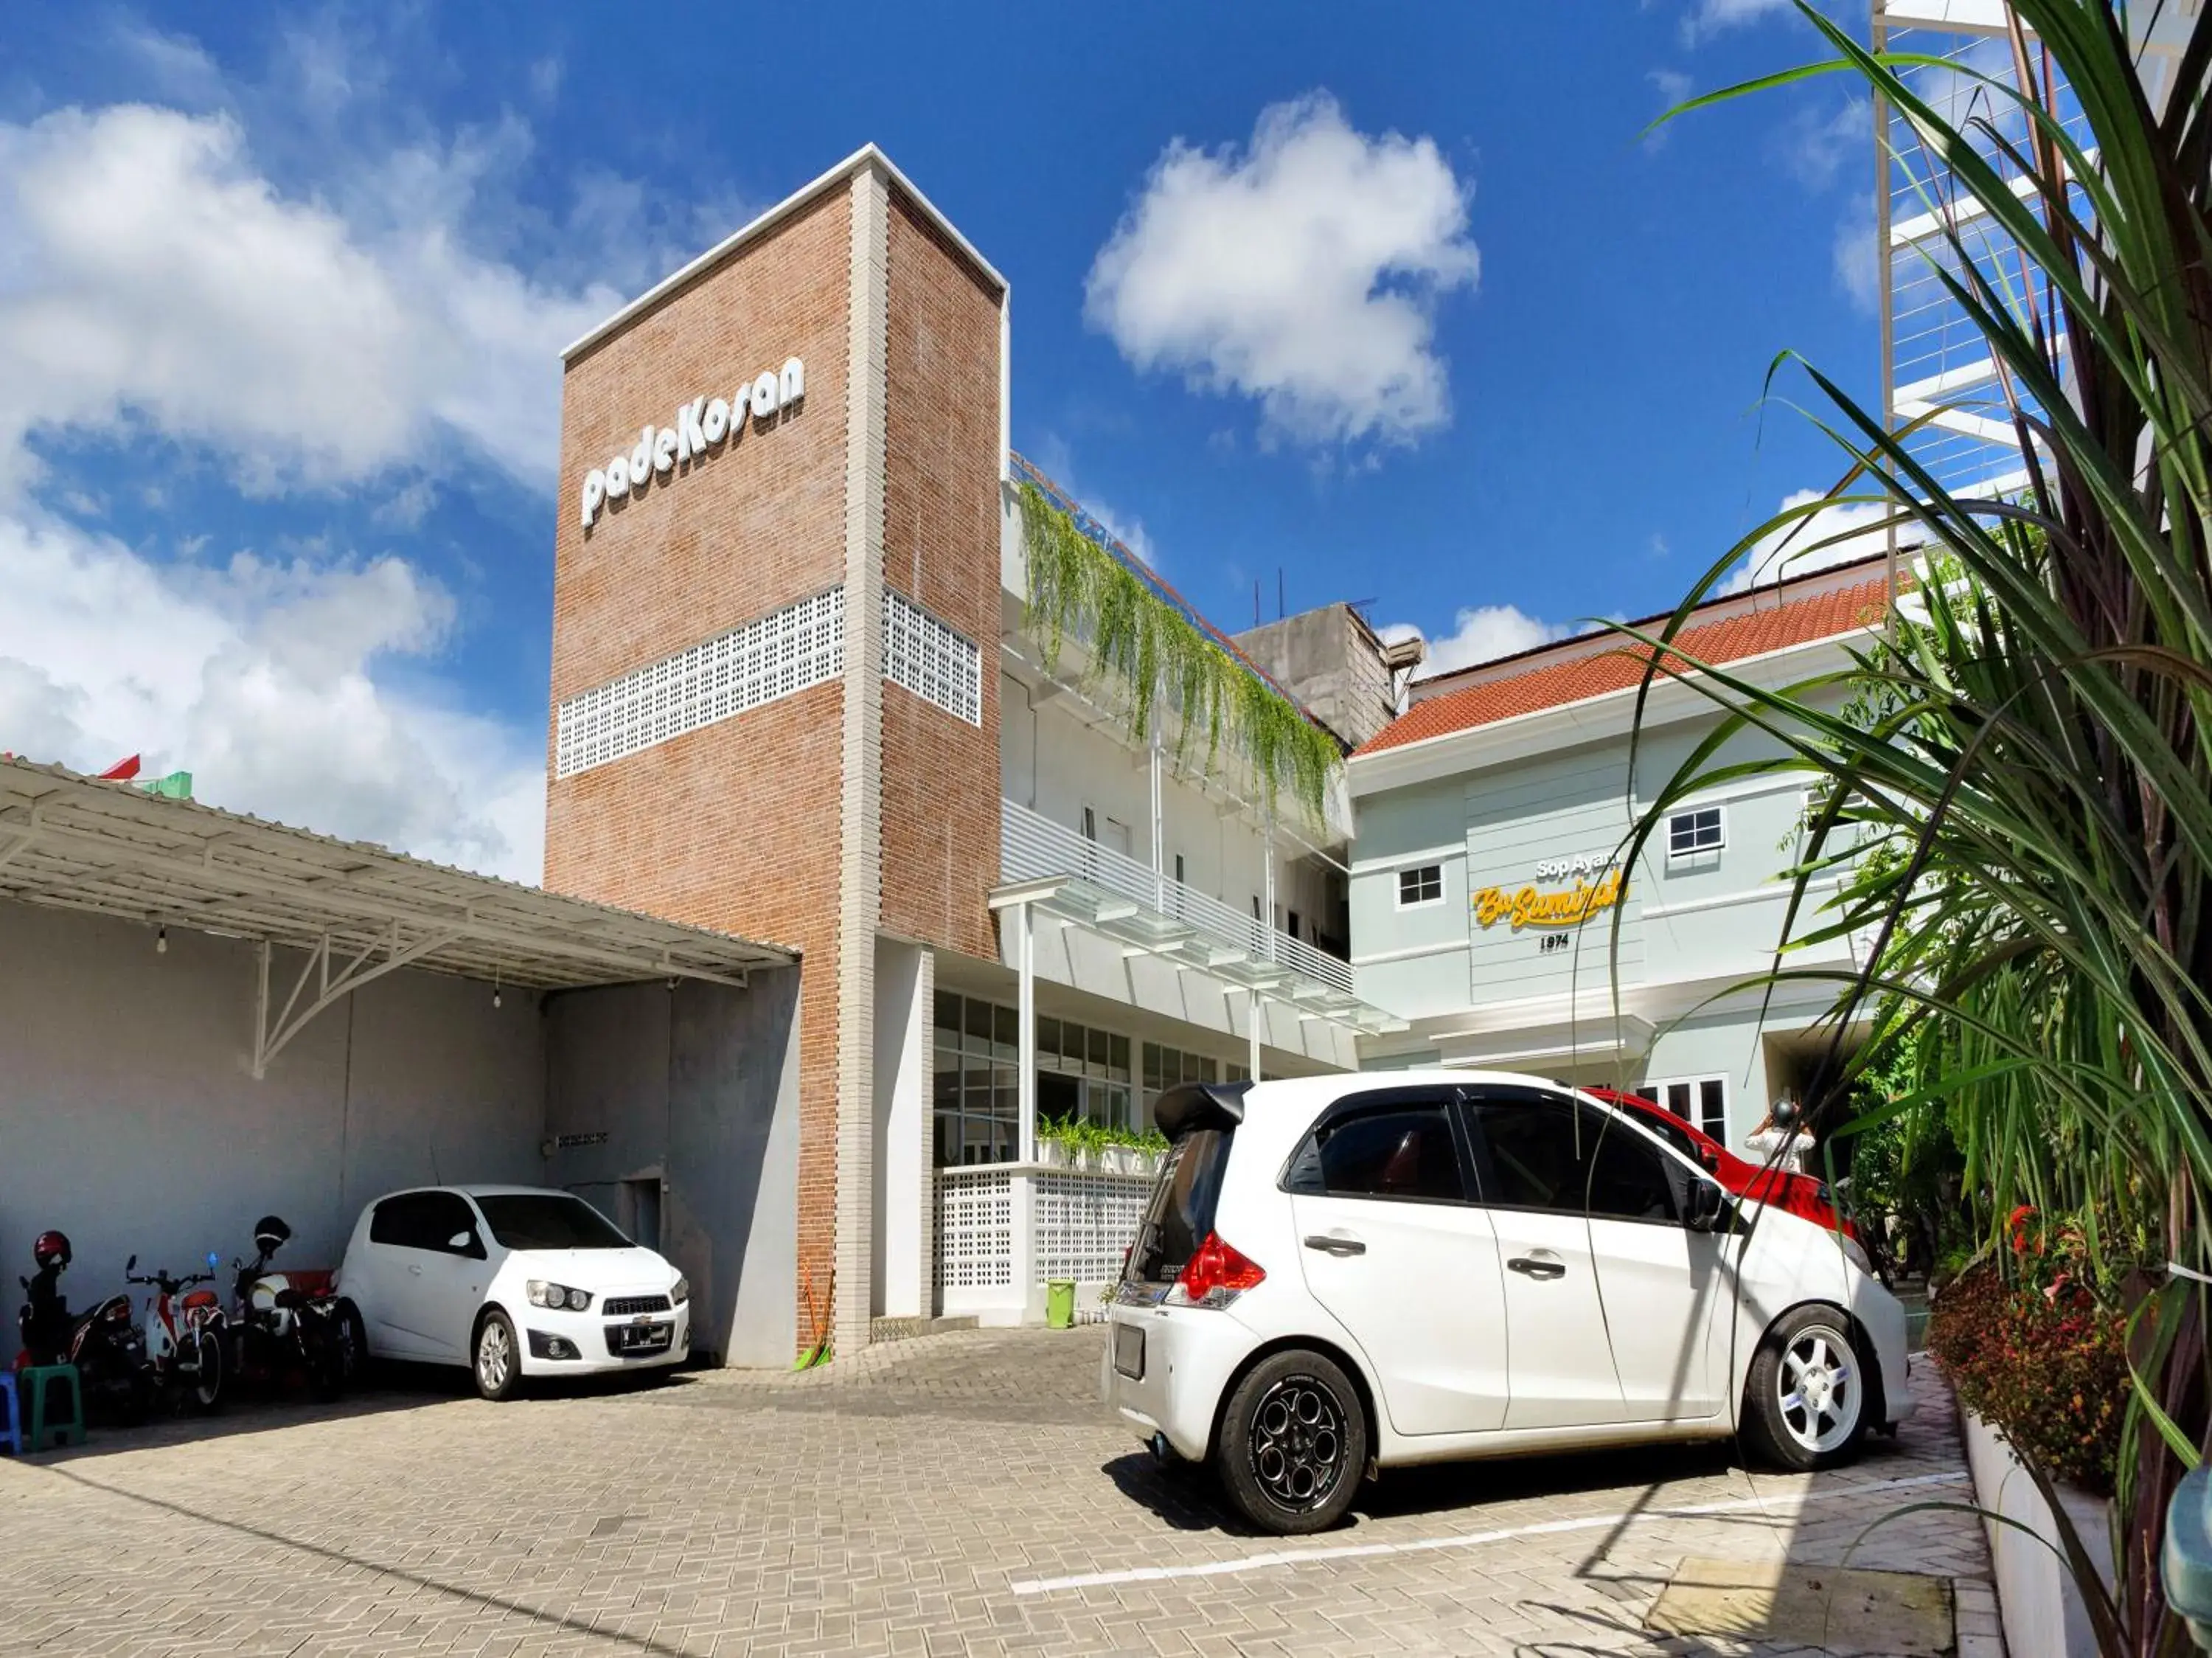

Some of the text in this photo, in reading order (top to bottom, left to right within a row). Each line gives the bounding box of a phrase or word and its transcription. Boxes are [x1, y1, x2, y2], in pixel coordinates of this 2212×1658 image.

[1536, 850, 1621, 878] Sop Ayam
[1474, 887, 1512, 926] Bu
[1540, 932, 1569, 949] 1974
